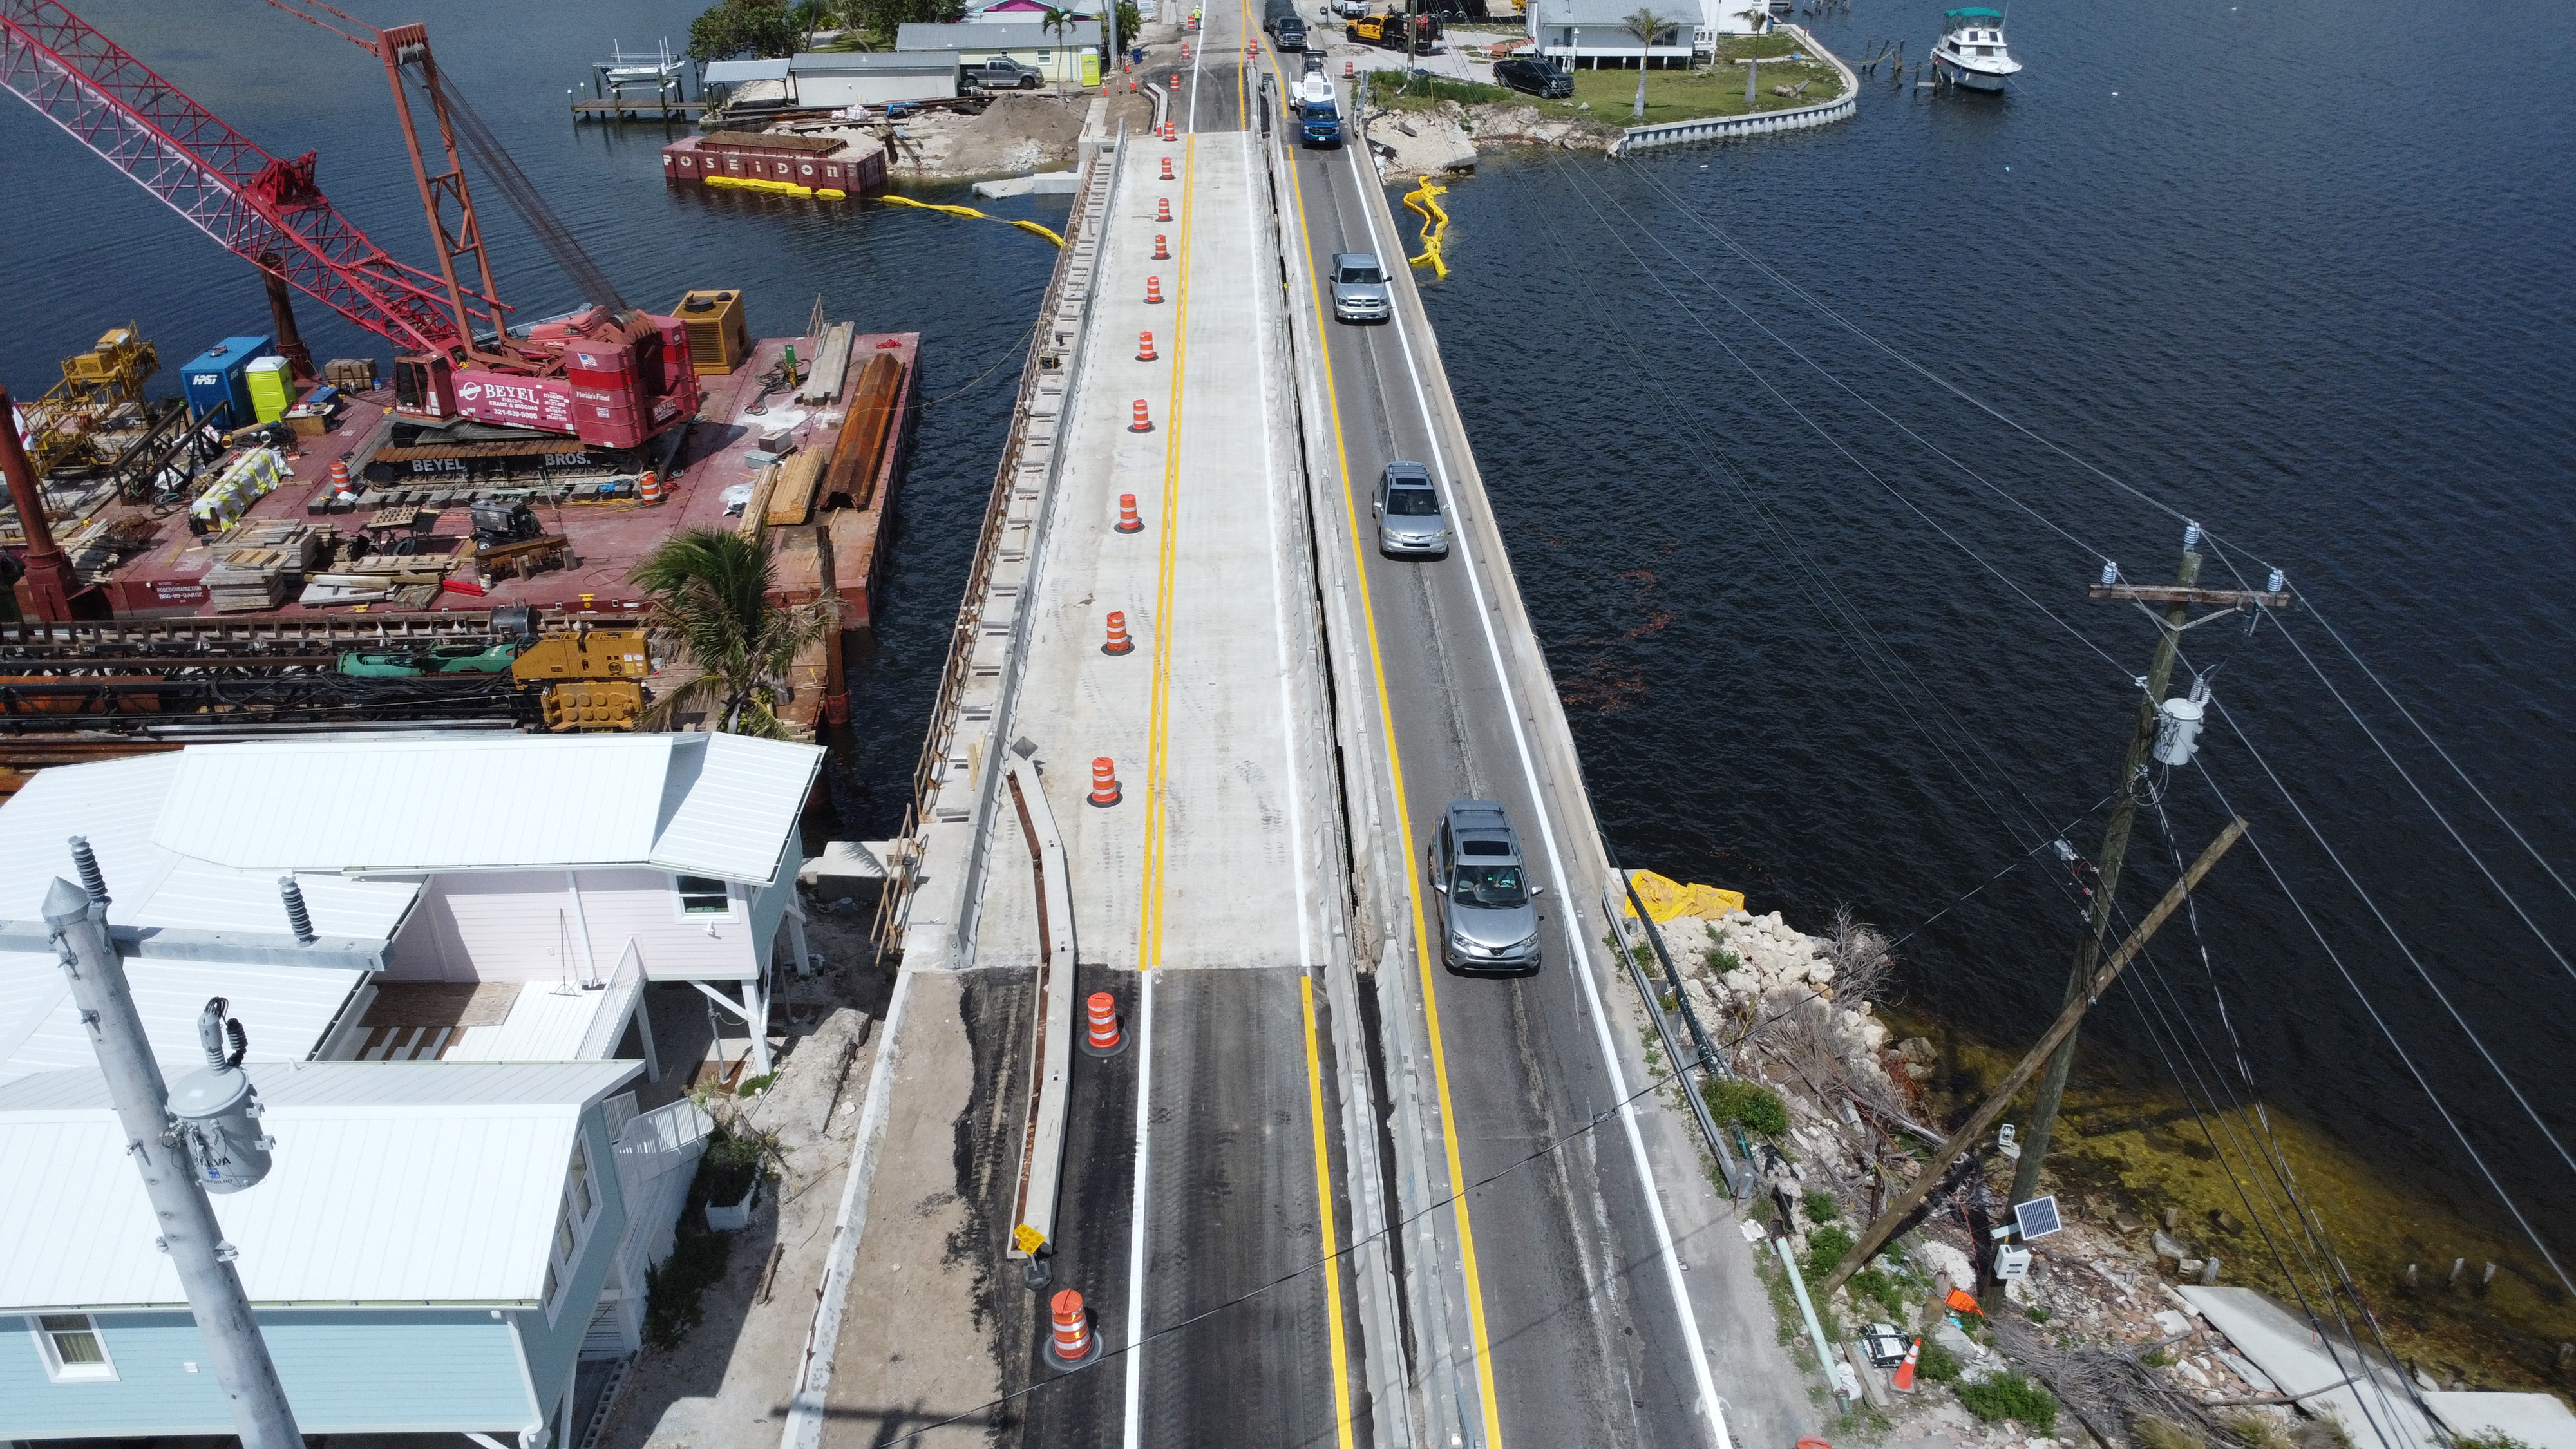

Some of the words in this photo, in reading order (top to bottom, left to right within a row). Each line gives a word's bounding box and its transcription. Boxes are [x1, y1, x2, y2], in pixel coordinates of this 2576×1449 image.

[484, 383, 540, 405] BEYEL
[412, 457, 466, 473] BEYEL
[544, 451, 591, 467] BROS.
